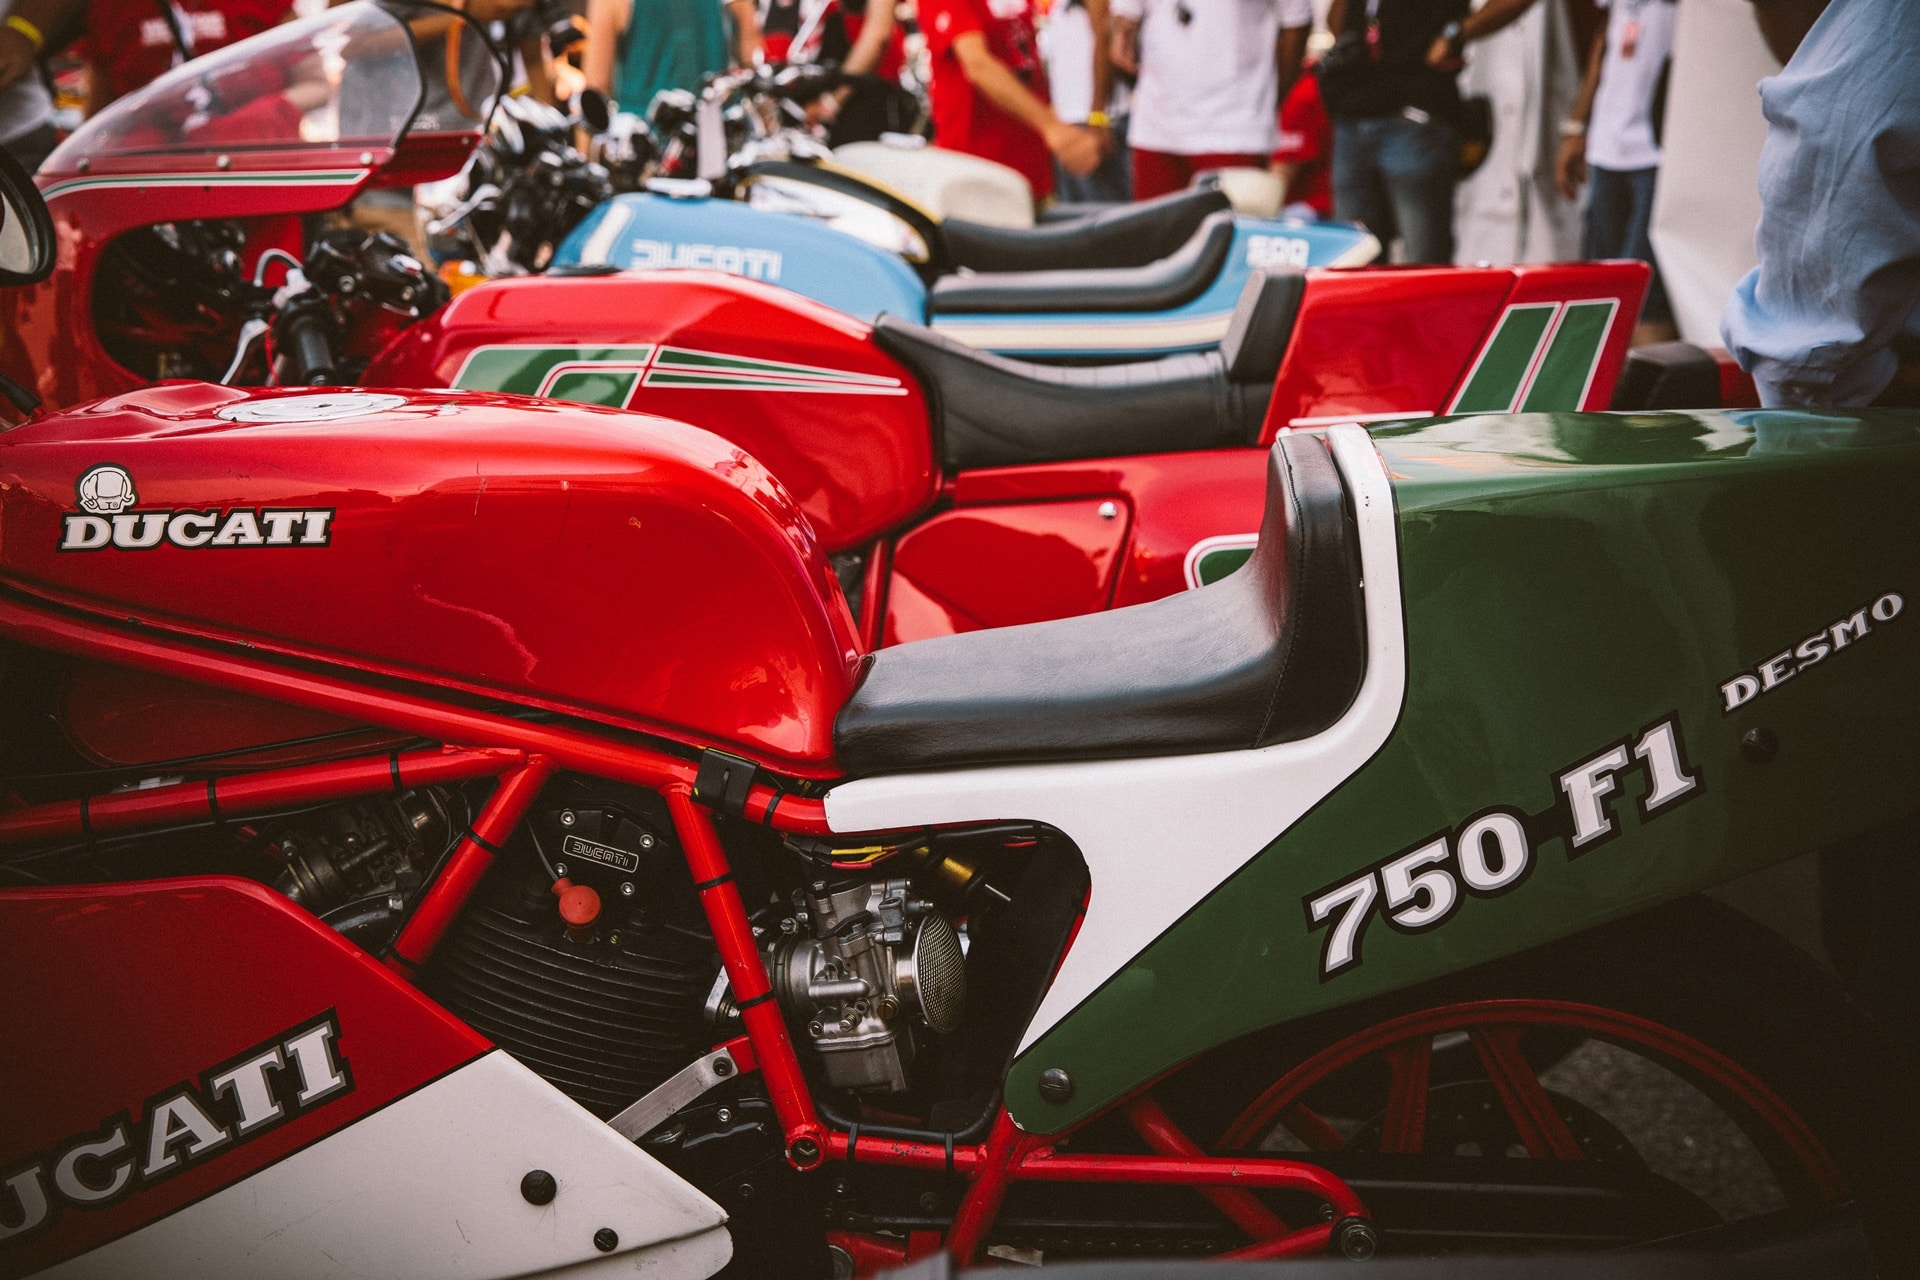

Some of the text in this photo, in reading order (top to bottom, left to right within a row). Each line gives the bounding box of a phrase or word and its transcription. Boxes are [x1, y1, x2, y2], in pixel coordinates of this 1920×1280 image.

[61, 511, 331, 550] DUCATI
[1721, 593, 1904, 712] DESMO
[572, 840, 629, 867] DUCATI
[1310, 720, 1697, 974] 750 F1
